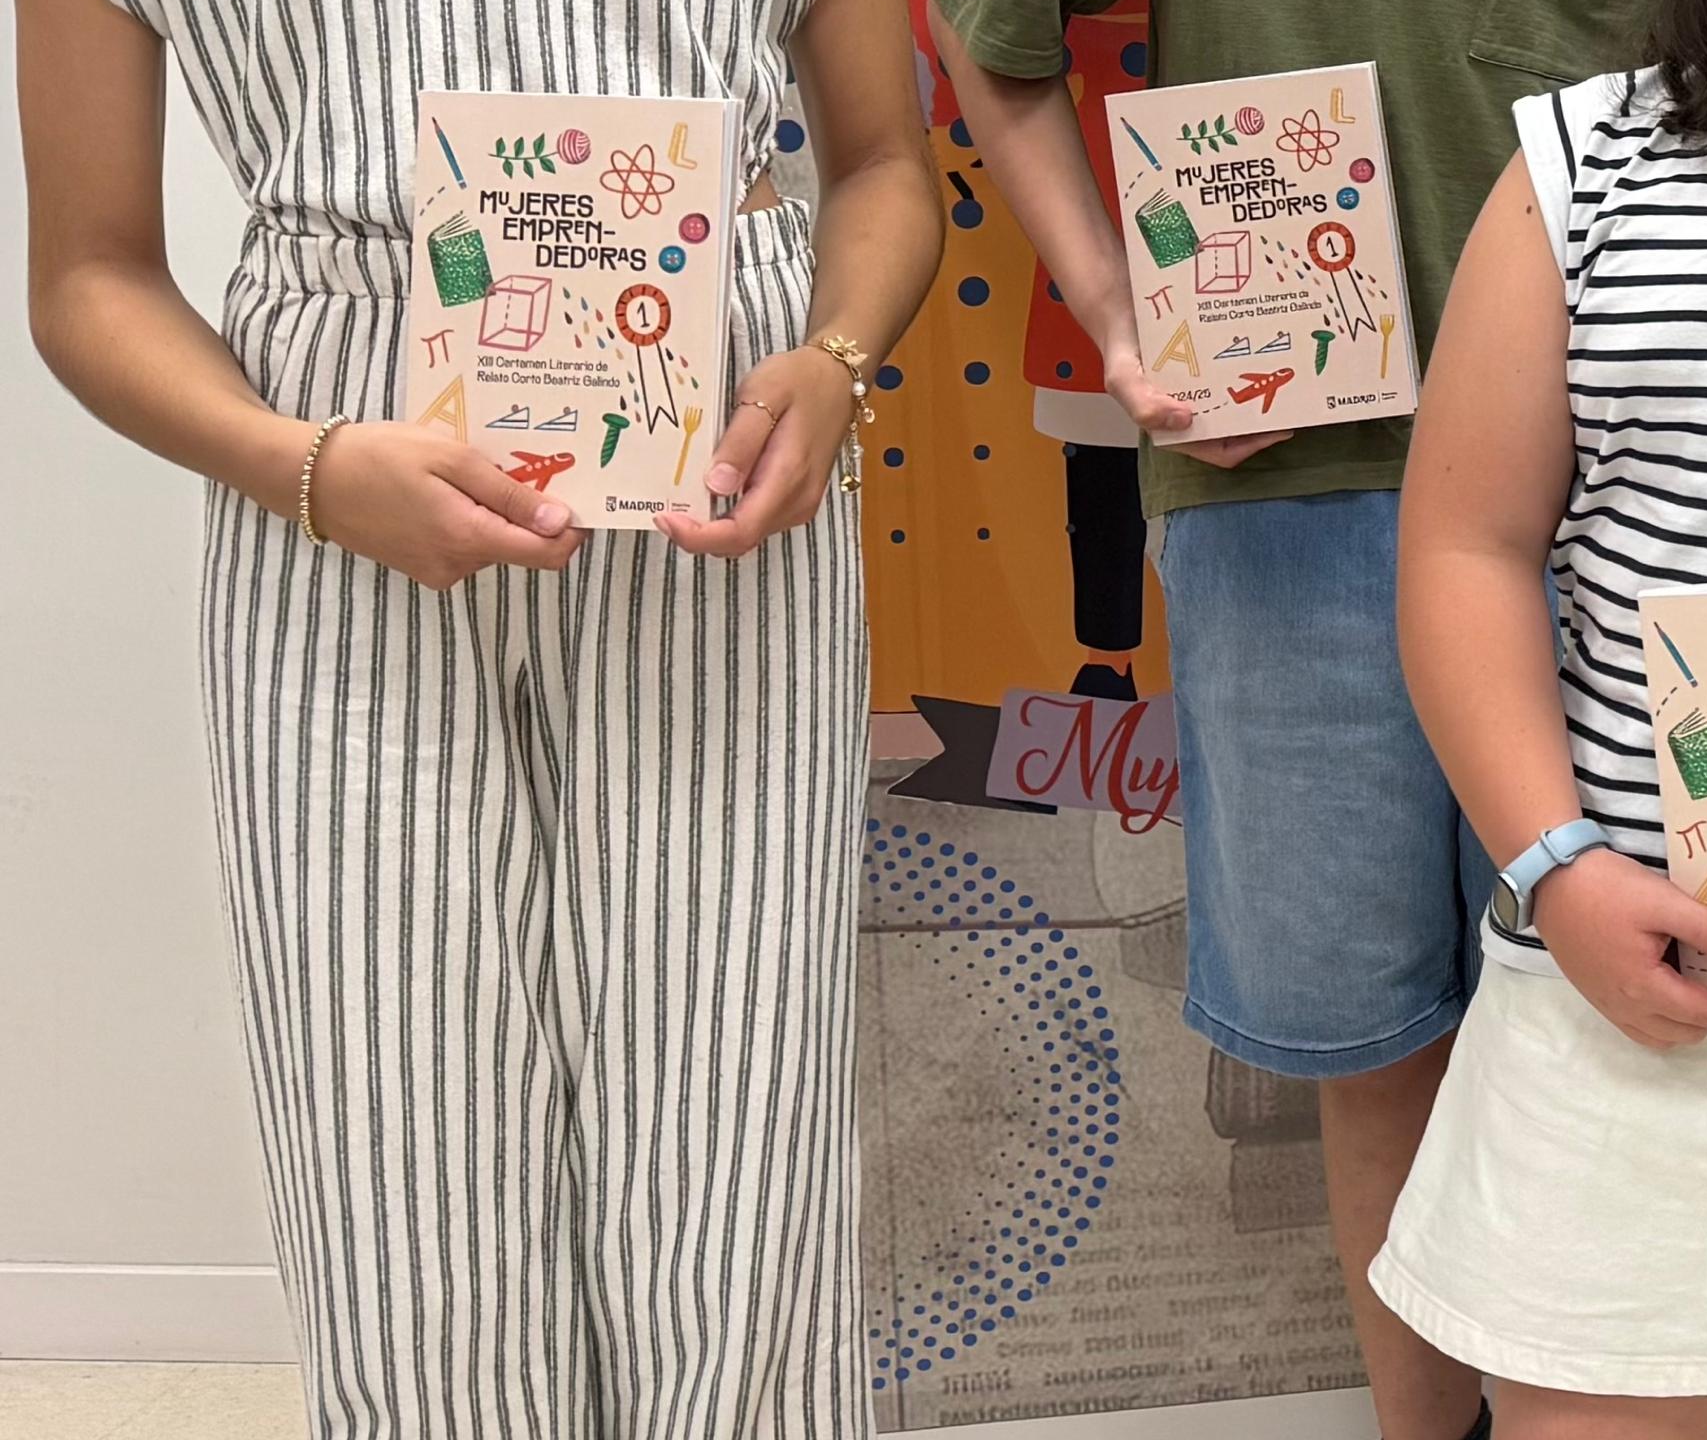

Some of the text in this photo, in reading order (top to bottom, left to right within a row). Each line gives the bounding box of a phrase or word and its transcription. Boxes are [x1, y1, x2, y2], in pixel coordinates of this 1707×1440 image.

[1174, 157, 1276, 188] MUJERES
[478, 190, 594, 218] MUJERES
[1198, 176, 1298, 206] EMPREN-
[1231, 193, 1328, 224] DEDORAS
[502, 217, 616, 245] EMPREN-
[535, 243, 647, 272] DEDORAS
[1325, 235, 1339, 258] 1
[636, 300, 650, 328] 1
[618, 500, 664, 514] MADRID
